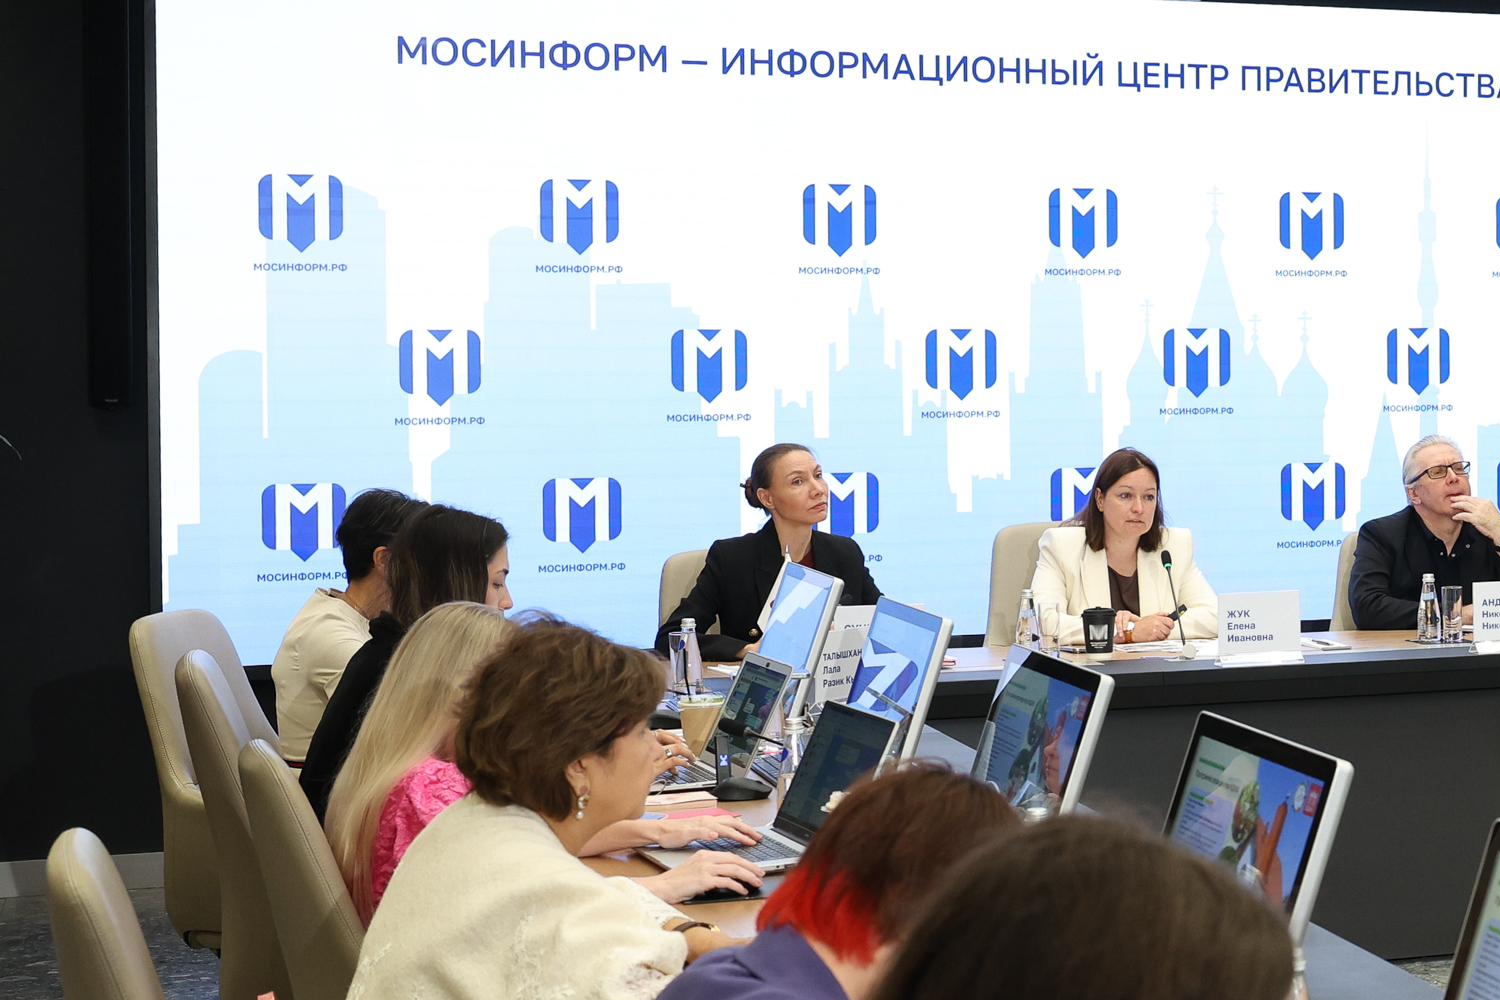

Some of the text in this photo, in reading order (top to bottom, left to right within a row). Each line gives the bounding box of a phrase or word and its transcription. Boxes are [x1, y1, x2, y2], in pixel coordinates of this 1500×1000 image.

[397, 35, 667, 73] МОСИНФОРМ
[721, 47, 1104, 87] ИНФОРМАЦИОННЫЙ
[1117, 61, 1229, 93] ЦЕНТР
[253, 262, 348, 272] МОСИНФОРМ.РФ
[535, 264, 624, 274] МОСИНФОРМ.РФ
[798, 266, 881, 276] МОСИНФОРМ.РФ
[1044, 267, 1122, 277] МОСИНФОРМ.РФ
[1275, 269, 1348, 278] МОСИНФОРМ.РФ
[1159, 406, 1234, 416] МОСИНФОРМ.РФ
[1382, 404, 1453, 413] МОСИНФОРМ.РФ
[666, 413, 752, 423] МОСИНФОРМ.РФ
[920, 410, 1001, 420] МОСИНФОРМ.РФ
[394, 416, 486, 426] МОСИНФОРМ.РФ
[1276, 539, 1342, 549] МОСИНФОРМ.Р
[538, 563, 626, 573] МОСИНФОРМ.РФ
[1227, 609, 1251, 618] ЖУК
[1227, 622, 1256, 630] Елена
[1227, 633, 1274, 642] Ивановна
[822, 665, 841, 675] Лала
[822, 678, 845, 688] Разик
